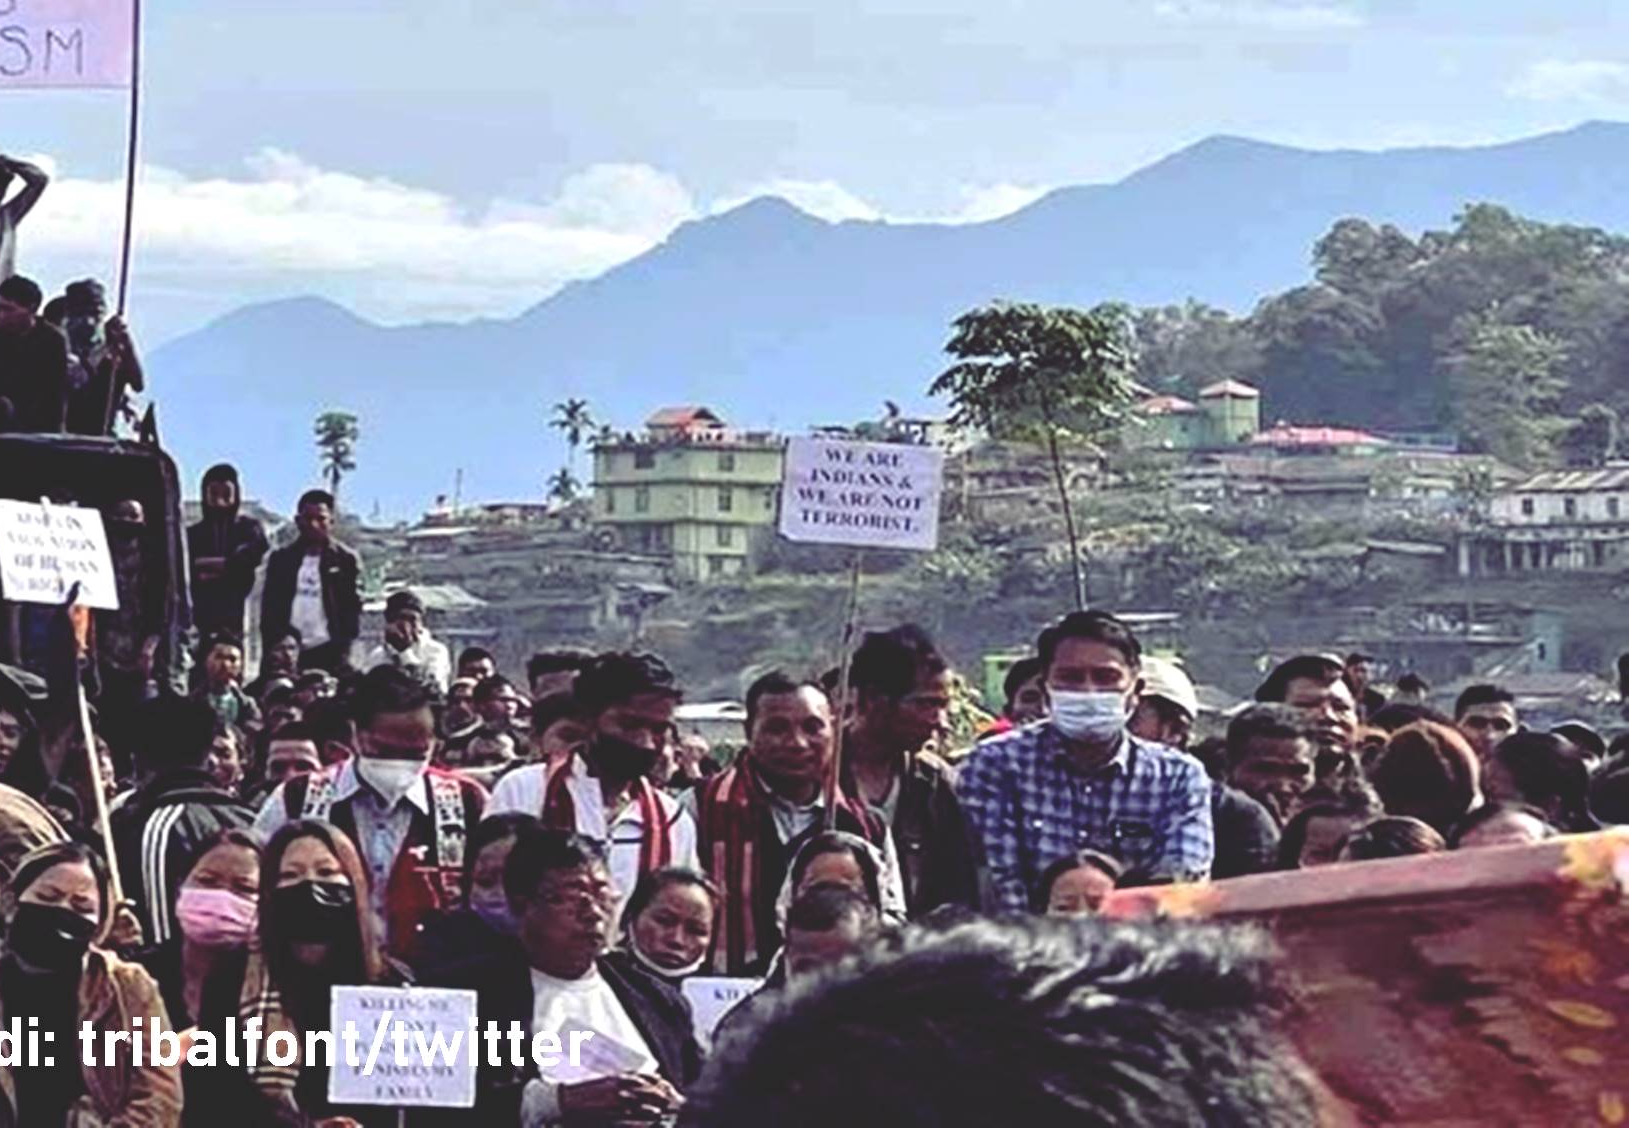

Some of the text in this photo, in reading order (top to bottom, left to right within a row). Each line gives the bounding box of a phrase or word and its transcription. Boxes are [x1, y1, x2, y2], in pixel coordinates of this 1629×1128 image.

[826, 448, 900, 467] WE ARE
[810, 468, 893, 486] INDIANS
[798, 487, 922, 510] WE ARE NOT
